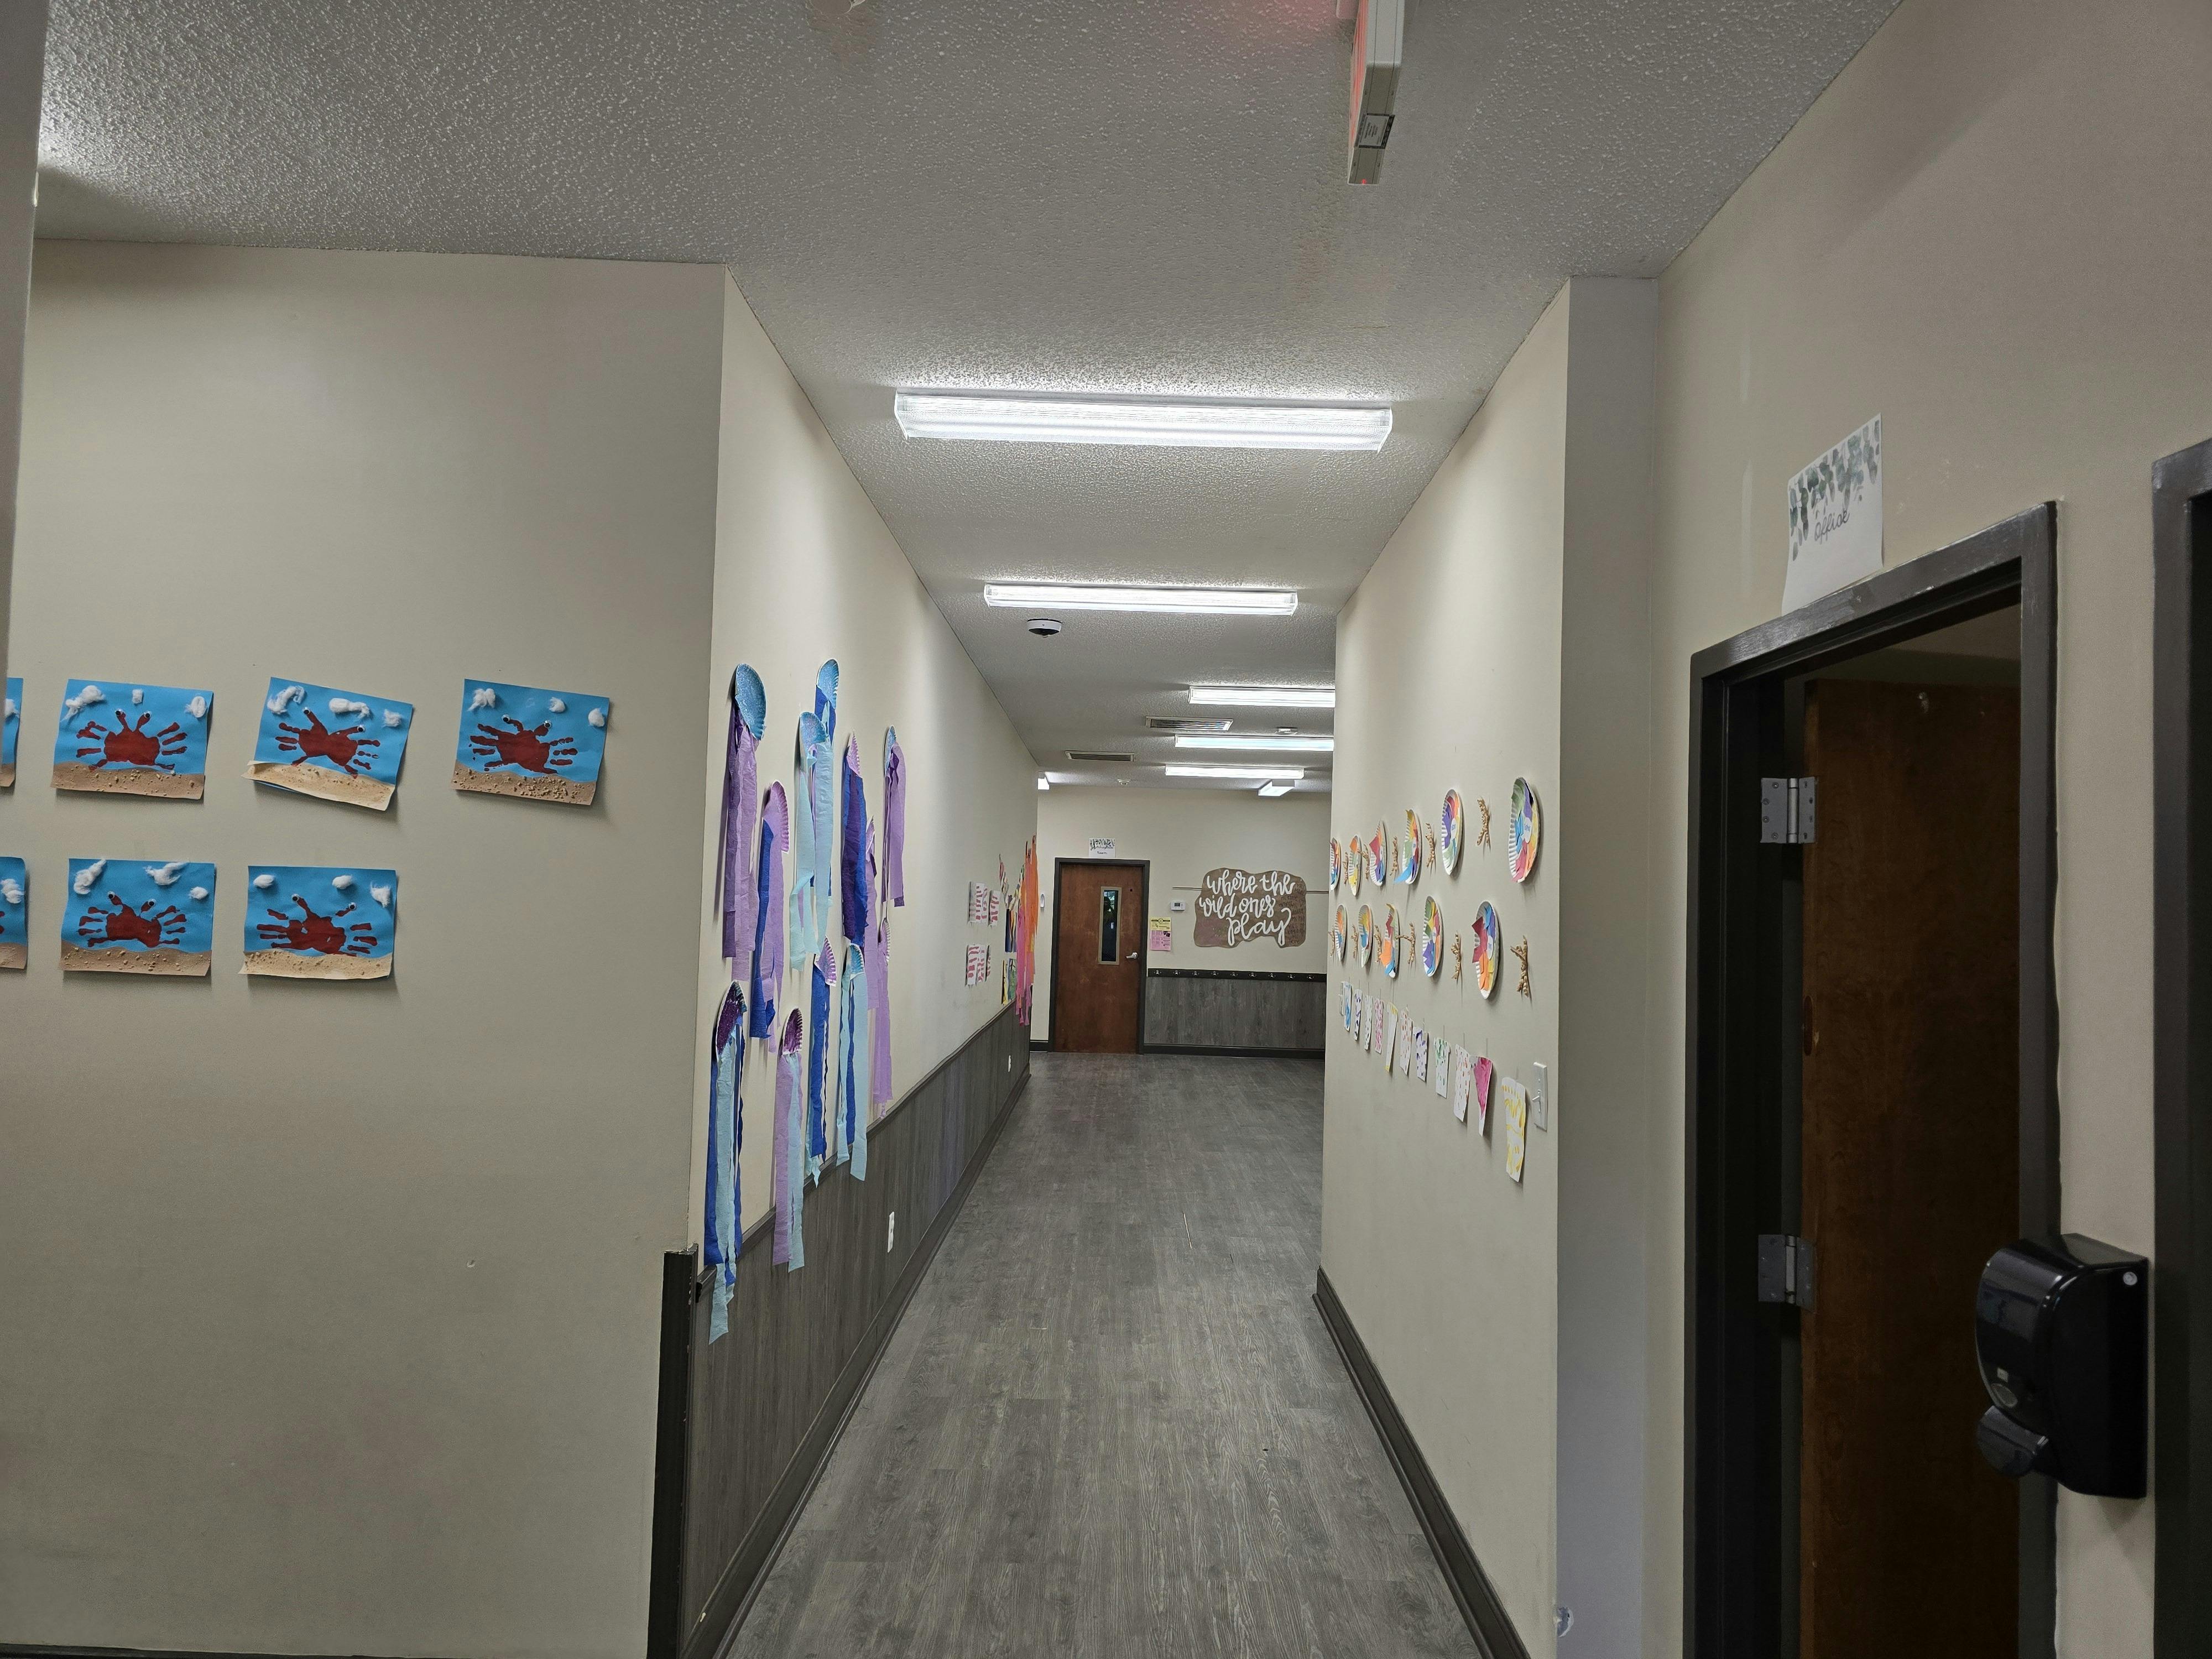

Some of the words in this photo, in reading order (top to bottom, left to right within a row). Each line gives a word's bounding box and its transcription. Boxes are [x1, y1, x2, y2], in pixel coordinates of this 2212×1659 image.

[1814, 510, 1850, 545] Office
[1206, 869, 1258, 896] where
[1259, 870, 1296, 896] the
[1198, 893, 1238, 919] wild
[1238, 894, 1276, 918] ones
[1226, 907, 1292, 946] play
